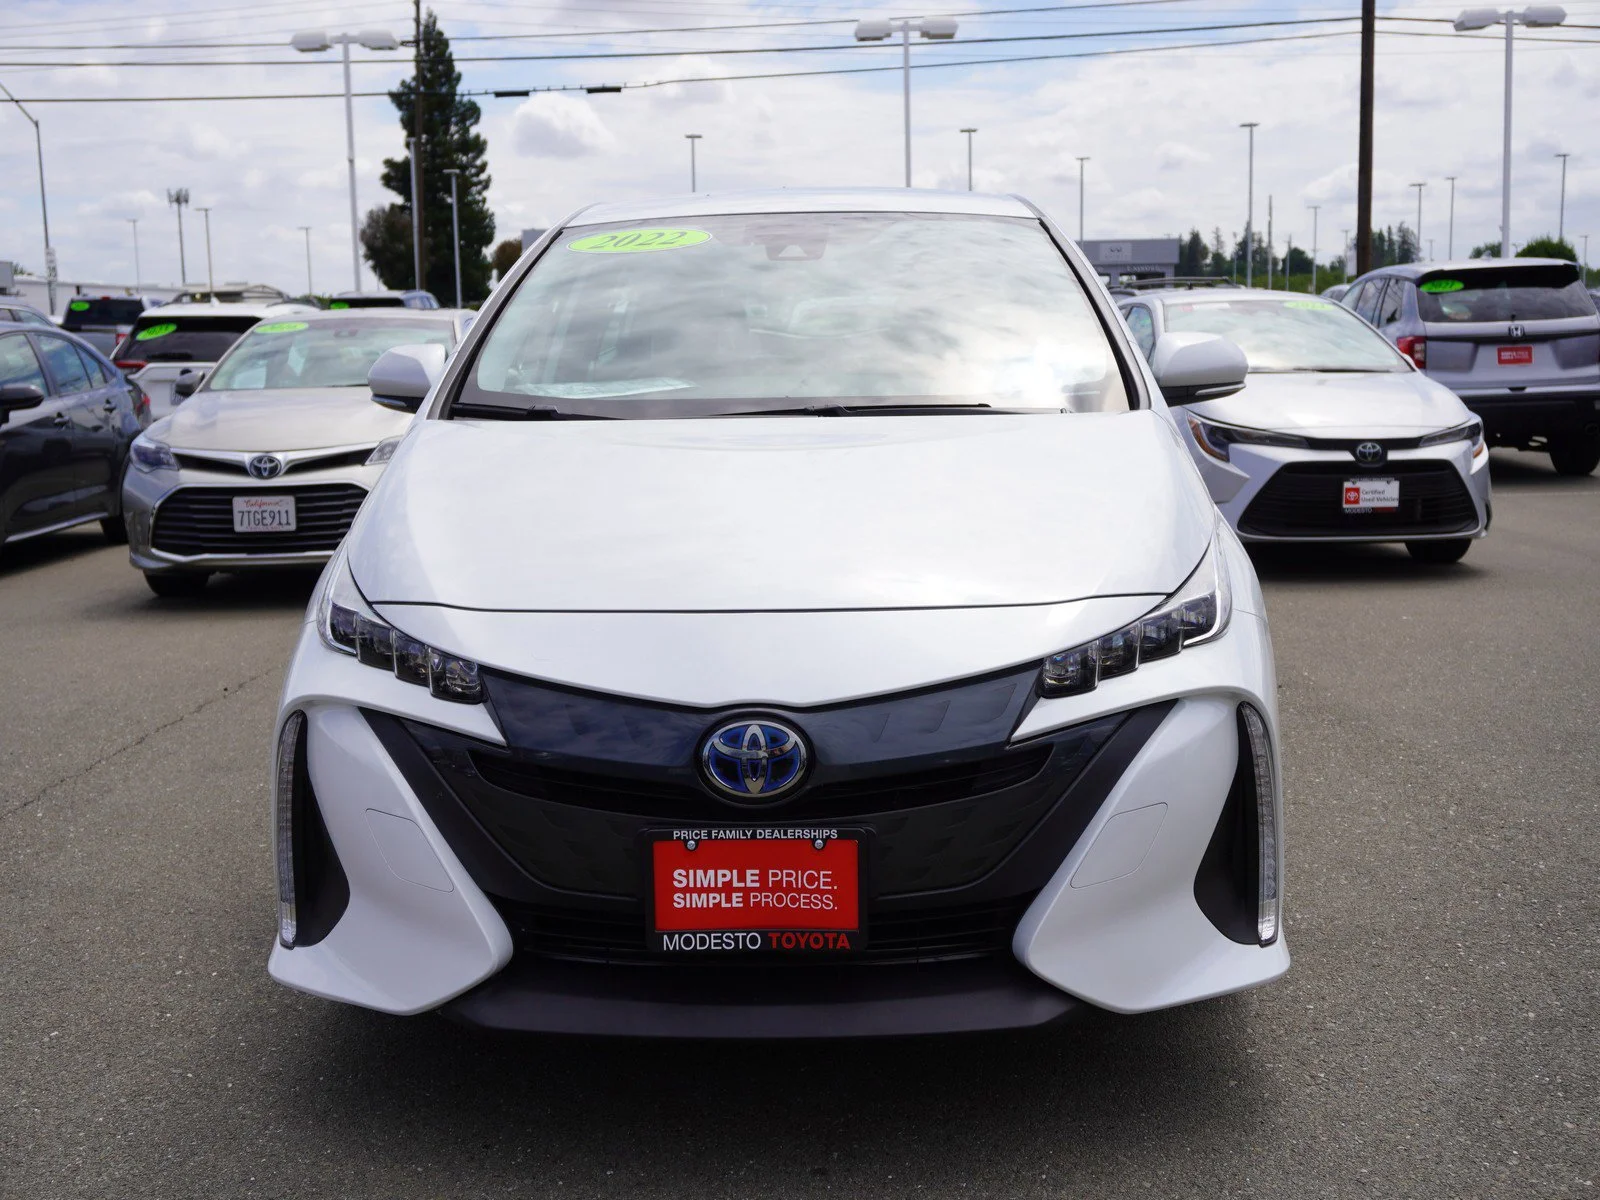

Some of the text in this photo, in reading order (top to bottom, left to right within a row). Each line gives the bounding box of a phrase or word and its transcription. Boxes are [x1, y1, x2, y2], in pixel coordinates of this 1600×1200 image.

[587, 231, 687, 250] 2022
[238, 509, 291, 527] 7TGE911
[673, 829, 838, 840] PRICE FAMILY DEALERSHIPS
[673, 869, 838, 890] SIMPLE PRICE.
[673, 892, 838, 910] SIMPLE PROCESS.
[663, 932, 850, 951] MODESTO TOYOTA
